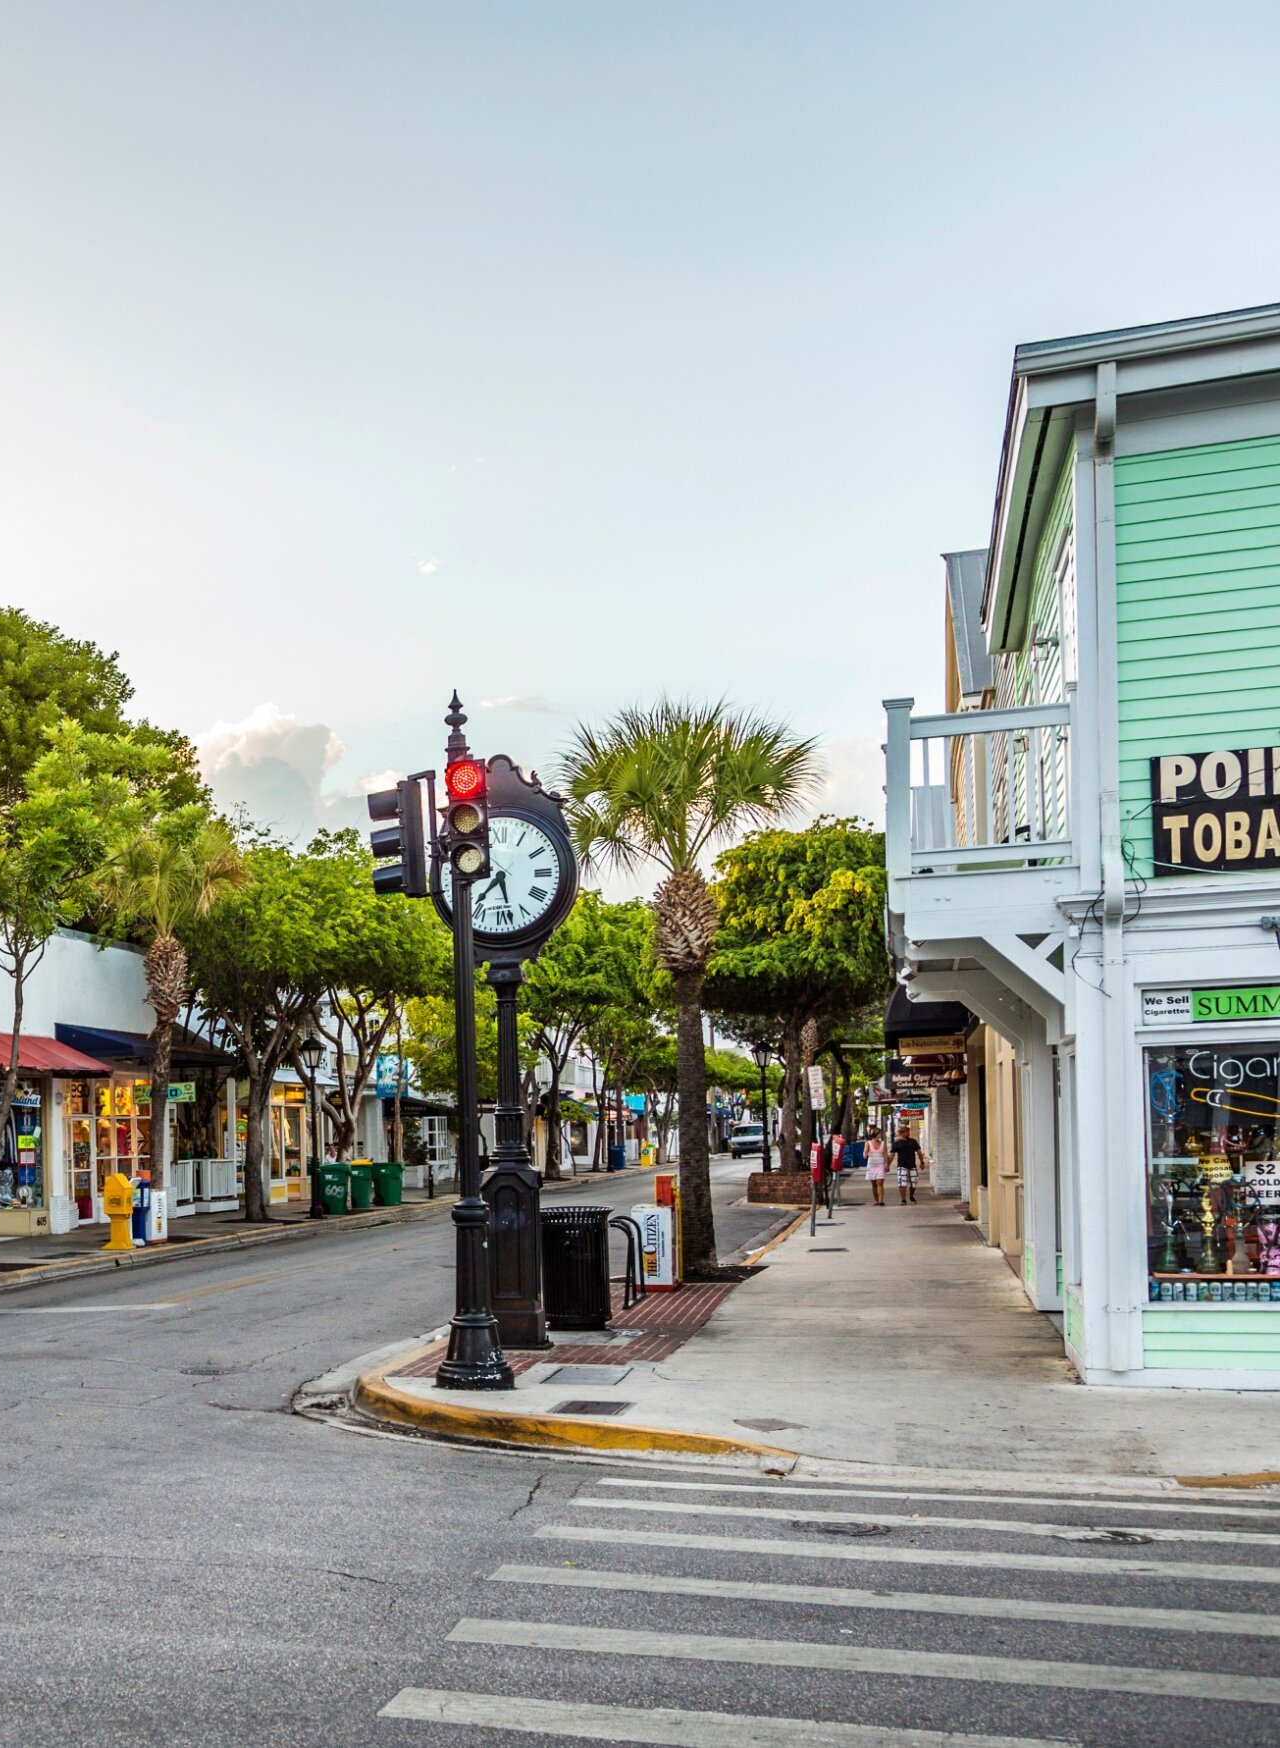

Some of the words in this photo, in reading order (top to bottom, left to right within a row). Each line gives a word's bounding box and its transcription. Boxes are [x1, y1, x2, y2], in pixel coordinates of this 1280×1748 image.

[1144, 997, 1163, 1005] We
[1166, 996, 1189, 1005] Sell
[1144, 1007, 1190, 1016] Cigarettes
[1255, 1163, 1276, 1176] $2
[642, 1214, 657, 1255] CITIZEN
[646, 1259, 657, 1279] THE
